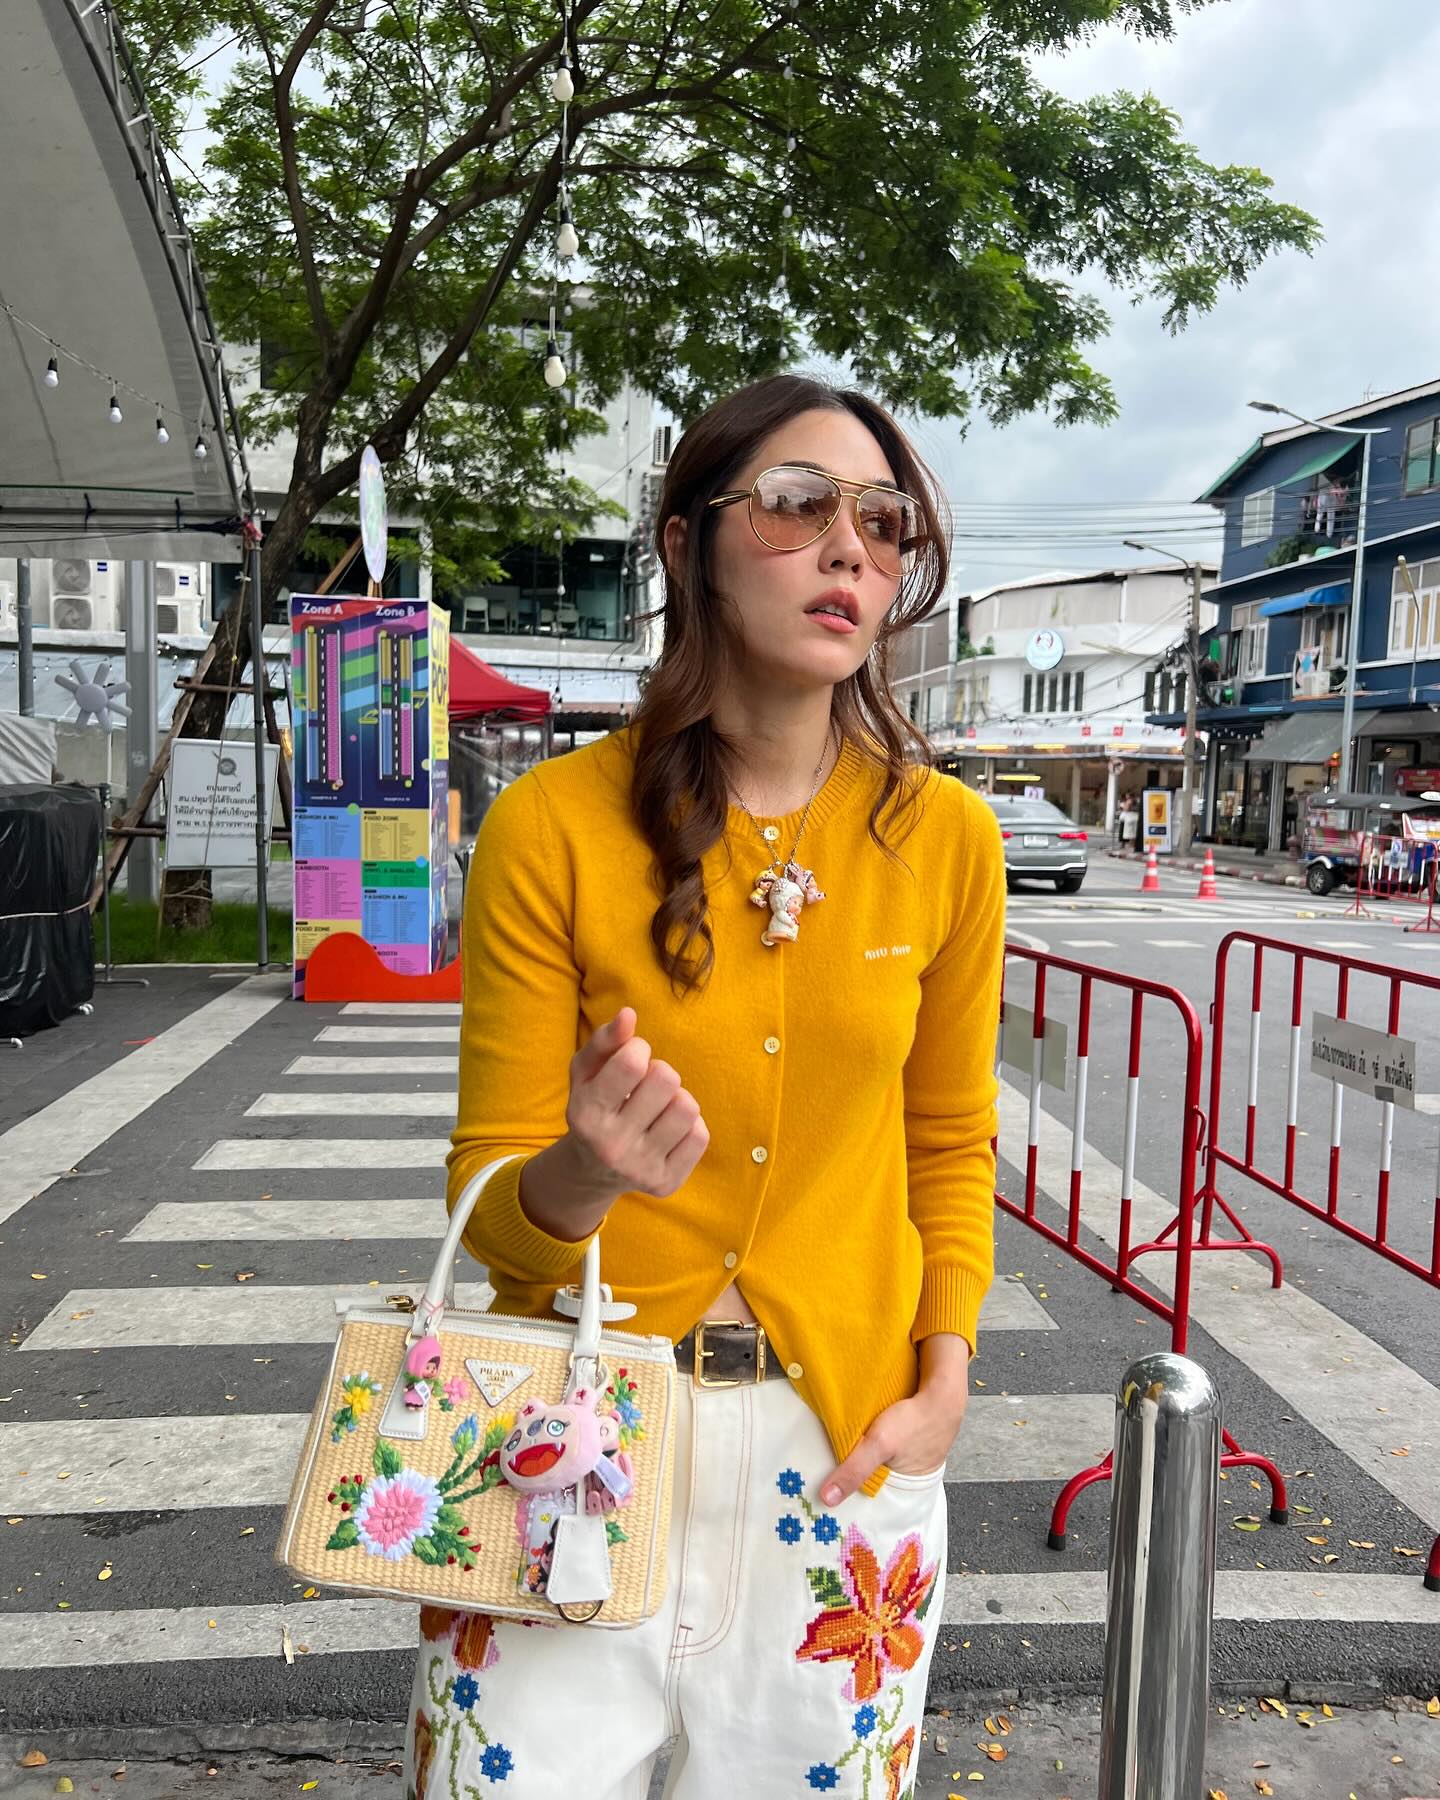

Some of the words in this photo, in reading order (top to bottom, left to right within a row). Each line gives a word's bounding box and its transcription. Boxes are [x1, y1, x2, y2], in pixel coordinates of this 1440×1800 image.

[302, 602, 331, 615] Zone
[334, 603, 343, 615] A
[376, 605, 405, 617] Zone
[407, 605, 415, 617] B
[432, 661, 448, 705] POP
[864, 948, 888, 960] miu
[891, 943, 912, 956] miu
[480, 1367, 514, 1377] PRADA
